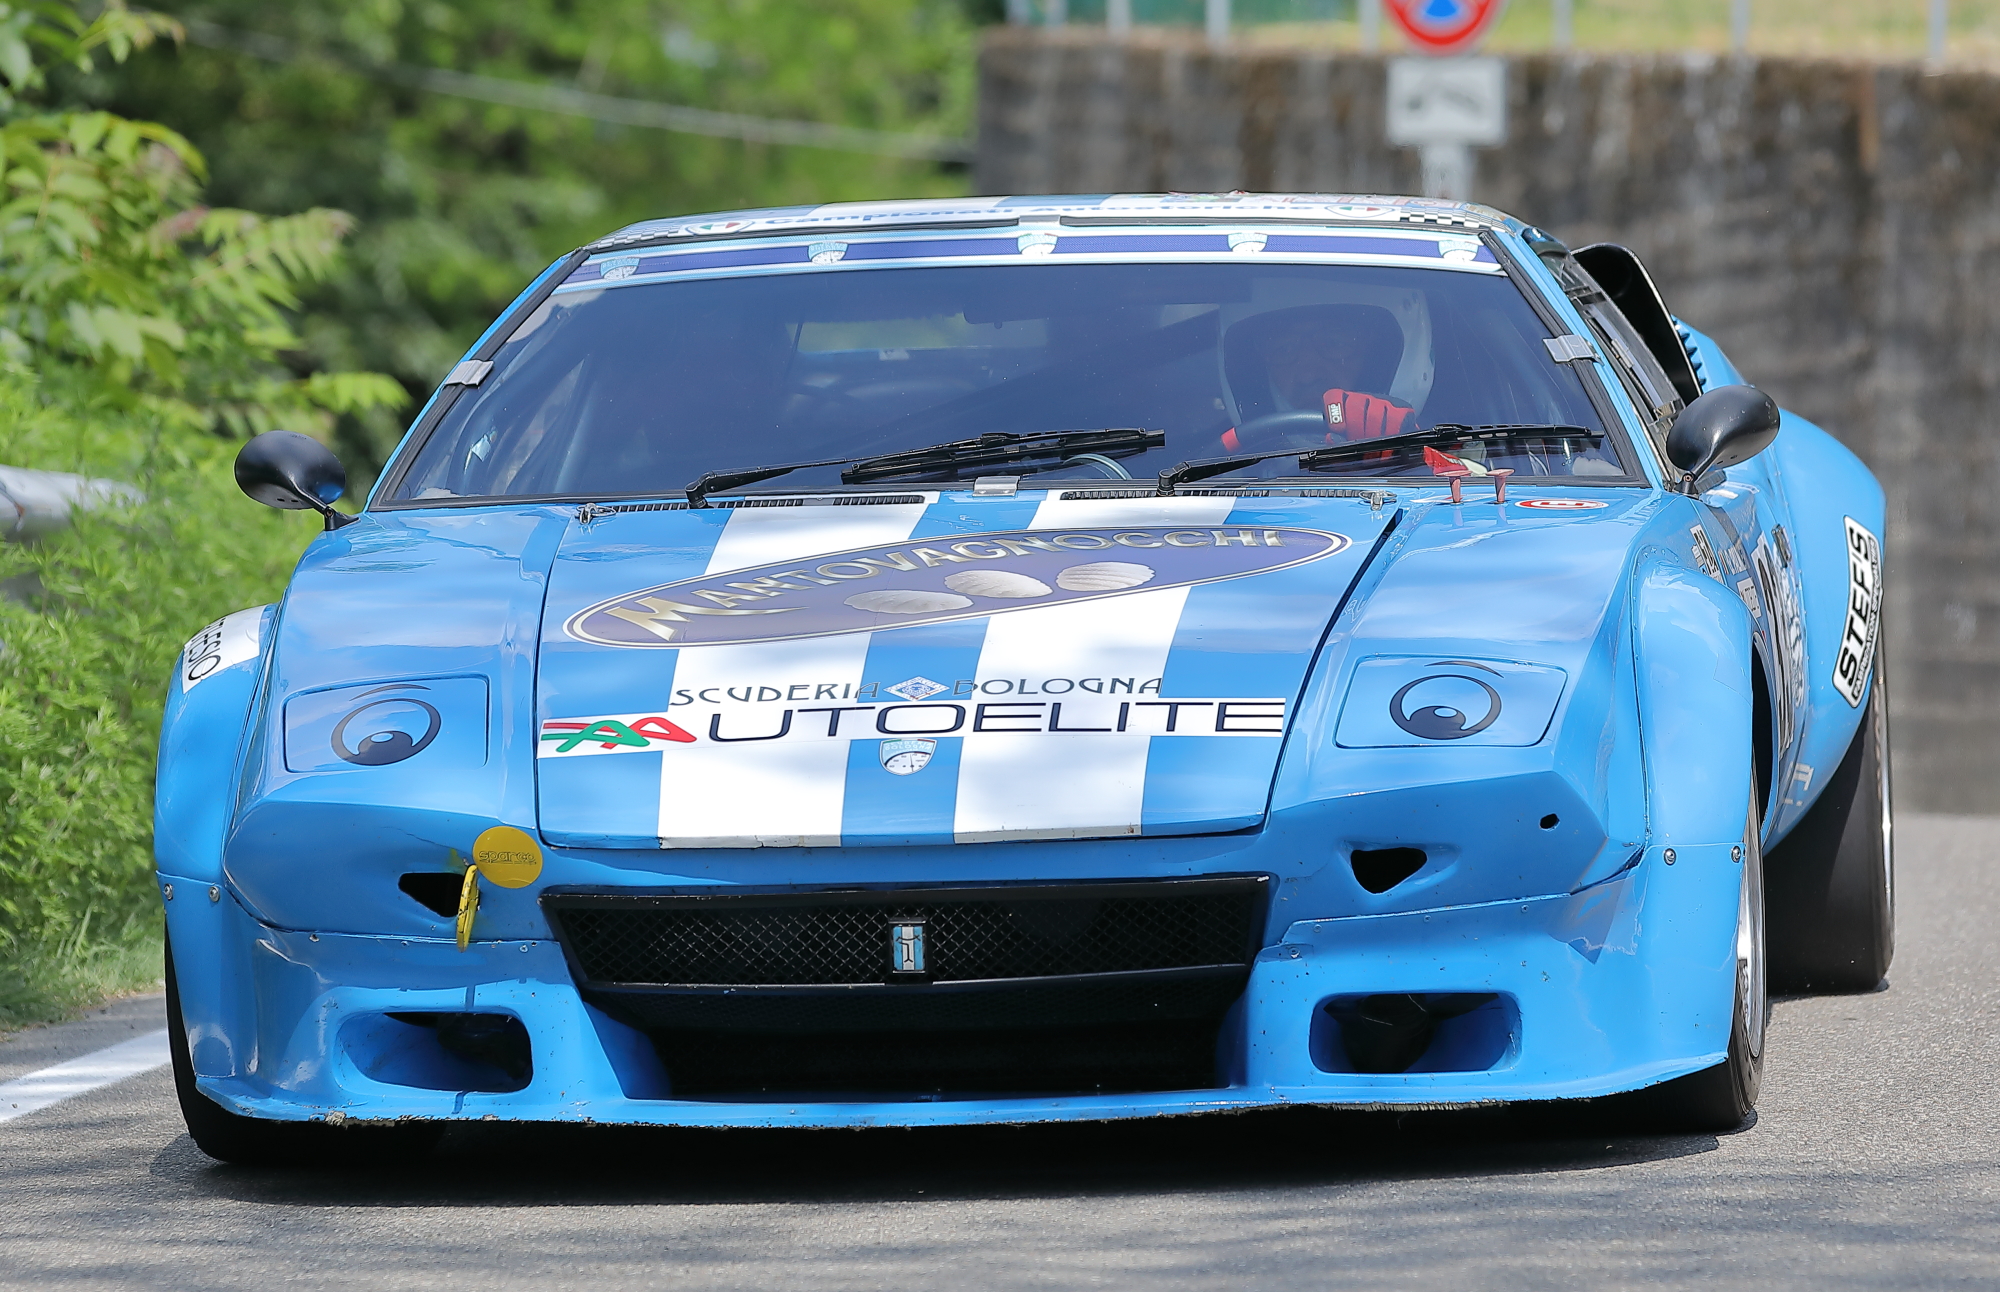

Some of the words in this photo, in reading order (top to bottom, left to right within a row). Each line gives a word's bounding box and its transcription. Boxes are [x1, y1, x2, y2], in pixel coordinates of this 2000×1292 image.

[765, 208, 1014, 225] Campionati
[1330, 403, 1341, 424] OMP
[604, 529, 1286, 639] MANTOVAGNOCCHI
[1839, 526, 1869, 686] STEF'S
[669, 681, 882, 706] SCUDERIA
[478, 850, 537, 864] sparco
